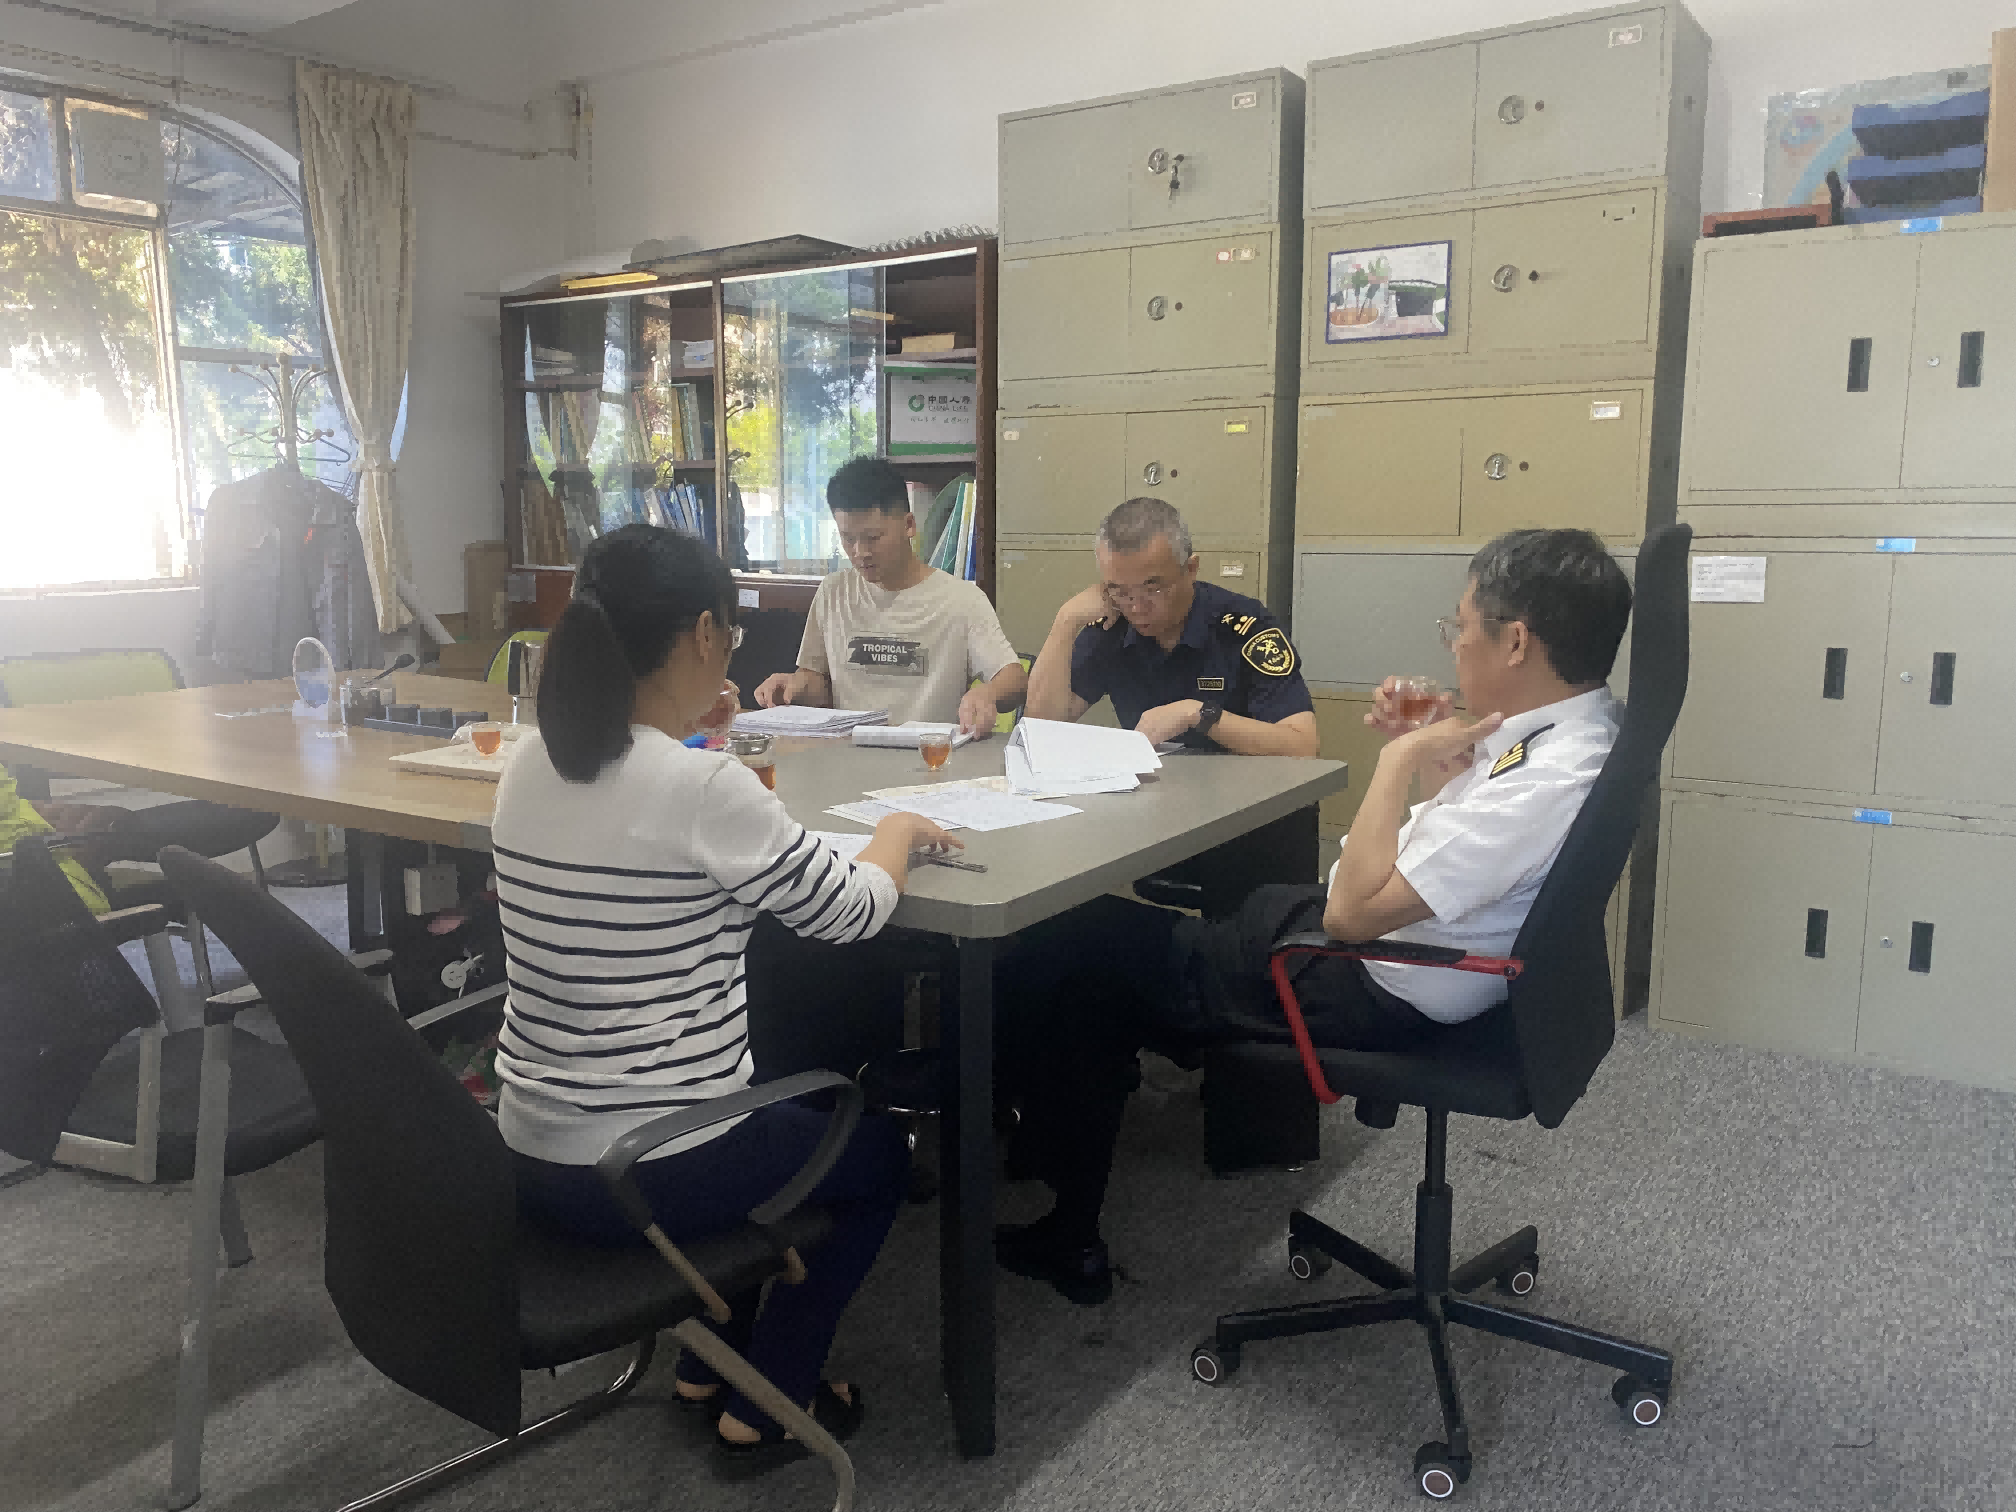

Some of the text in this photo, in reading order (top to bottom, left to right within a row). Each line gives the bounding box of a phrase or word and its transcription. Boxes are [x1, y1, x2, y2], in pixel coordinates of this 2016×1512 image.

[1254, 633, 1279, 643] CUSTOMS
[862, 643, 908, 654] TROPICAL
[871, 653, 898, 663] VIBES
